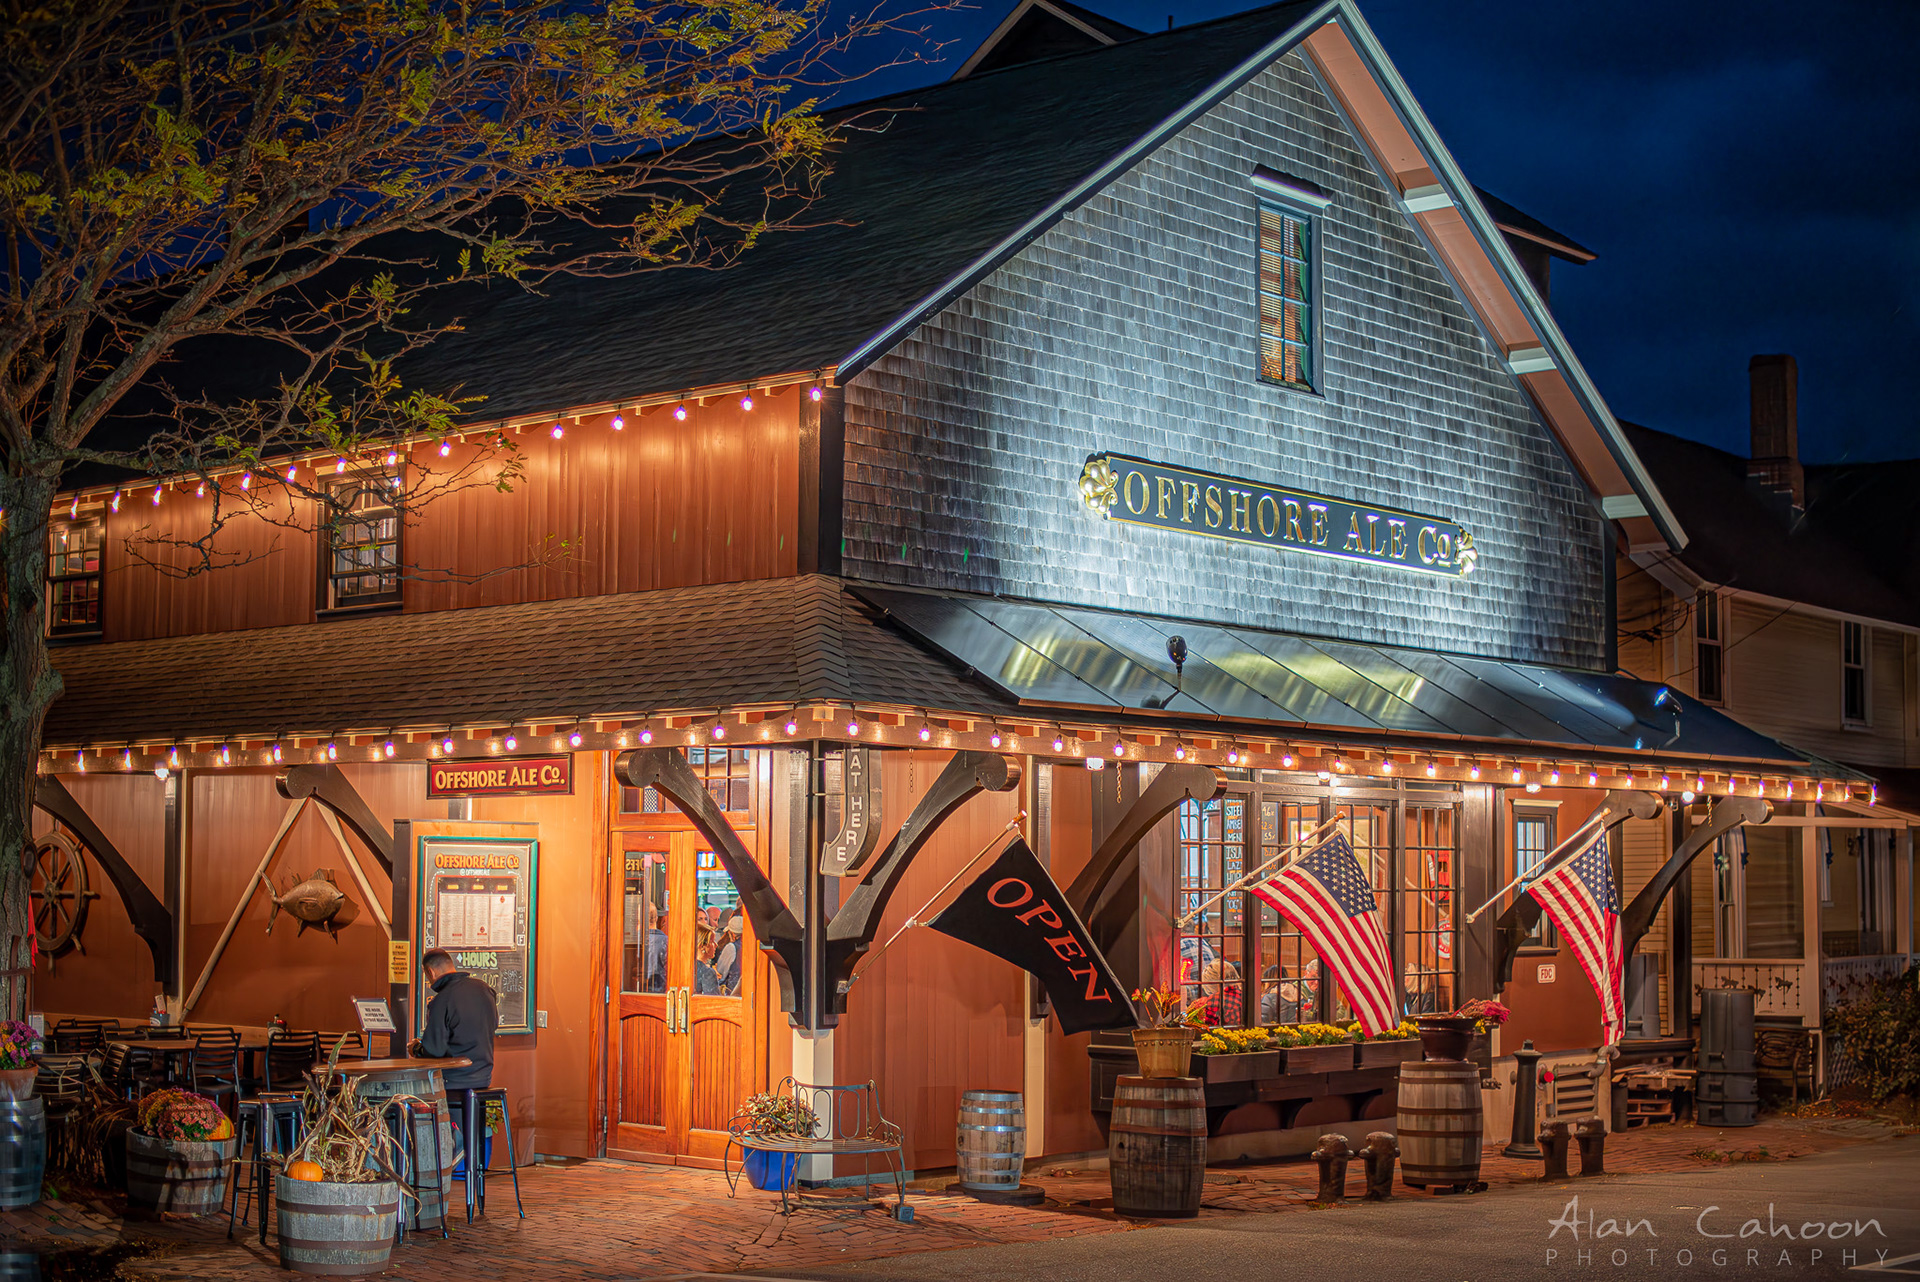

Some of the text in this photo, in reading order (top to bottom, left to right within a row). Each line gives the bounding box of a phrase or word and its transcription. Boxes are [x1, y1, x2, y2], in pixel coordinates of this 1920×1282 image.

[1123, 471, 1329, 547] OFFSHORE
[1342, 511, 1409, 560] ALE
[435, 770, 507, 790] OFFSHORE
[509, 766, 538, 788] ALE
[836, 748, 863, 862] AT HERE
[435, 853, 485, 869] OFFSHORE
[486, 852, 506, 869] ALE
[987, 877, 1113, 1004] OPEN
[462, 951, 498, 968] HOURS
[1540, 968, 1553, 979] FDC
